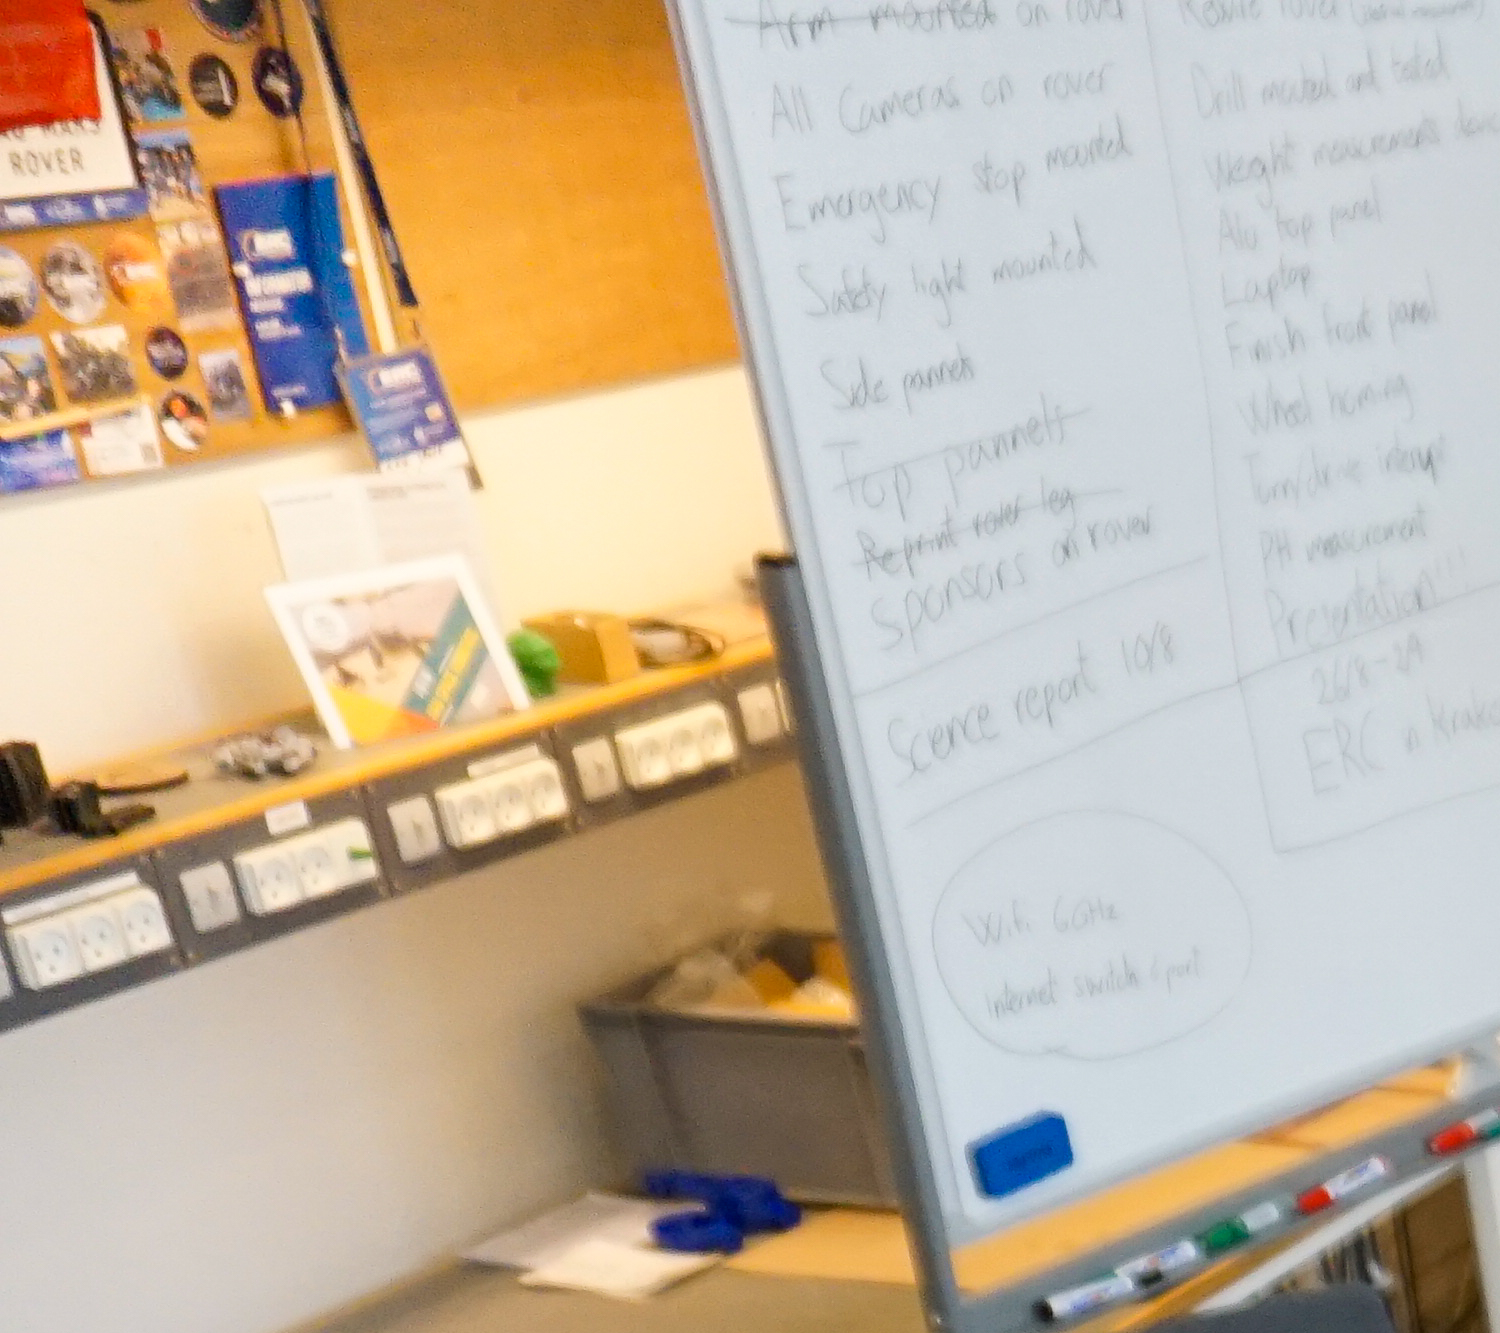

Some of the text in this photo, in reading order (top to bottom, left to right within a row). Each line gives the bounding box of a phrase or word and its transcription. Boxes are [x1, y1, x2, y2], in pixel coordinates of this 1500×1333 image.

[770, 82, 814, 138] All
[980, 73, 1014, 108] on
[1043, 62, 1114, 100] rover
[8, 147, 84, 176] ROVER
[1302, 708, 1386, 796] ERC
